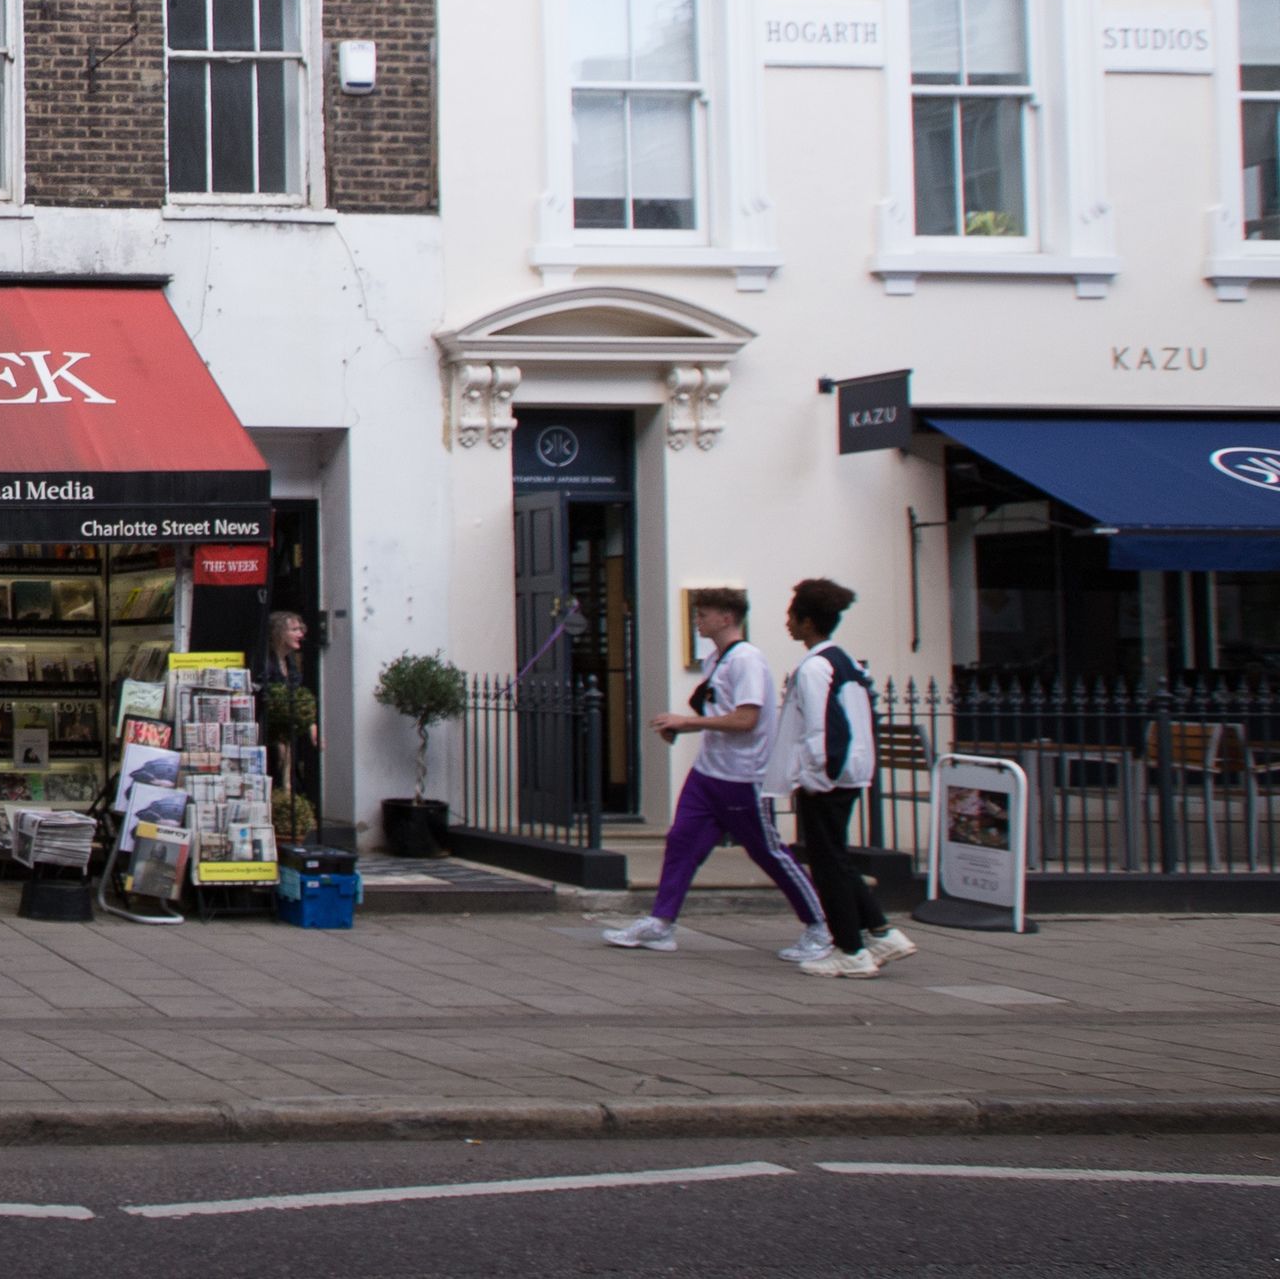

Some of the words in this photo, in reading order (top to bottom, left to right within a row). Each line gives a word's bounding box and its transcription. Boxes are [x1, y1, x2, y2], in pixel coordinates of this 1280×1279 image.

[767, 21, 878, 43] HOGARTH
[1103, 27, 1208, 50] STUDIOS
[1111, 346, 1208, 371] KAZU
[849, 405, 897, 428] KAZU
[27, 481, 94, 501] Media
[81, 520, 157, 537] Charlotte
[162, 519, 210, 536] Street
[214, 518, 259, 536] News
[202, 560, 226, 573] THE
[227, 559, 259, 572] WEEK
[962, 875, 1000, 892] KAZU
